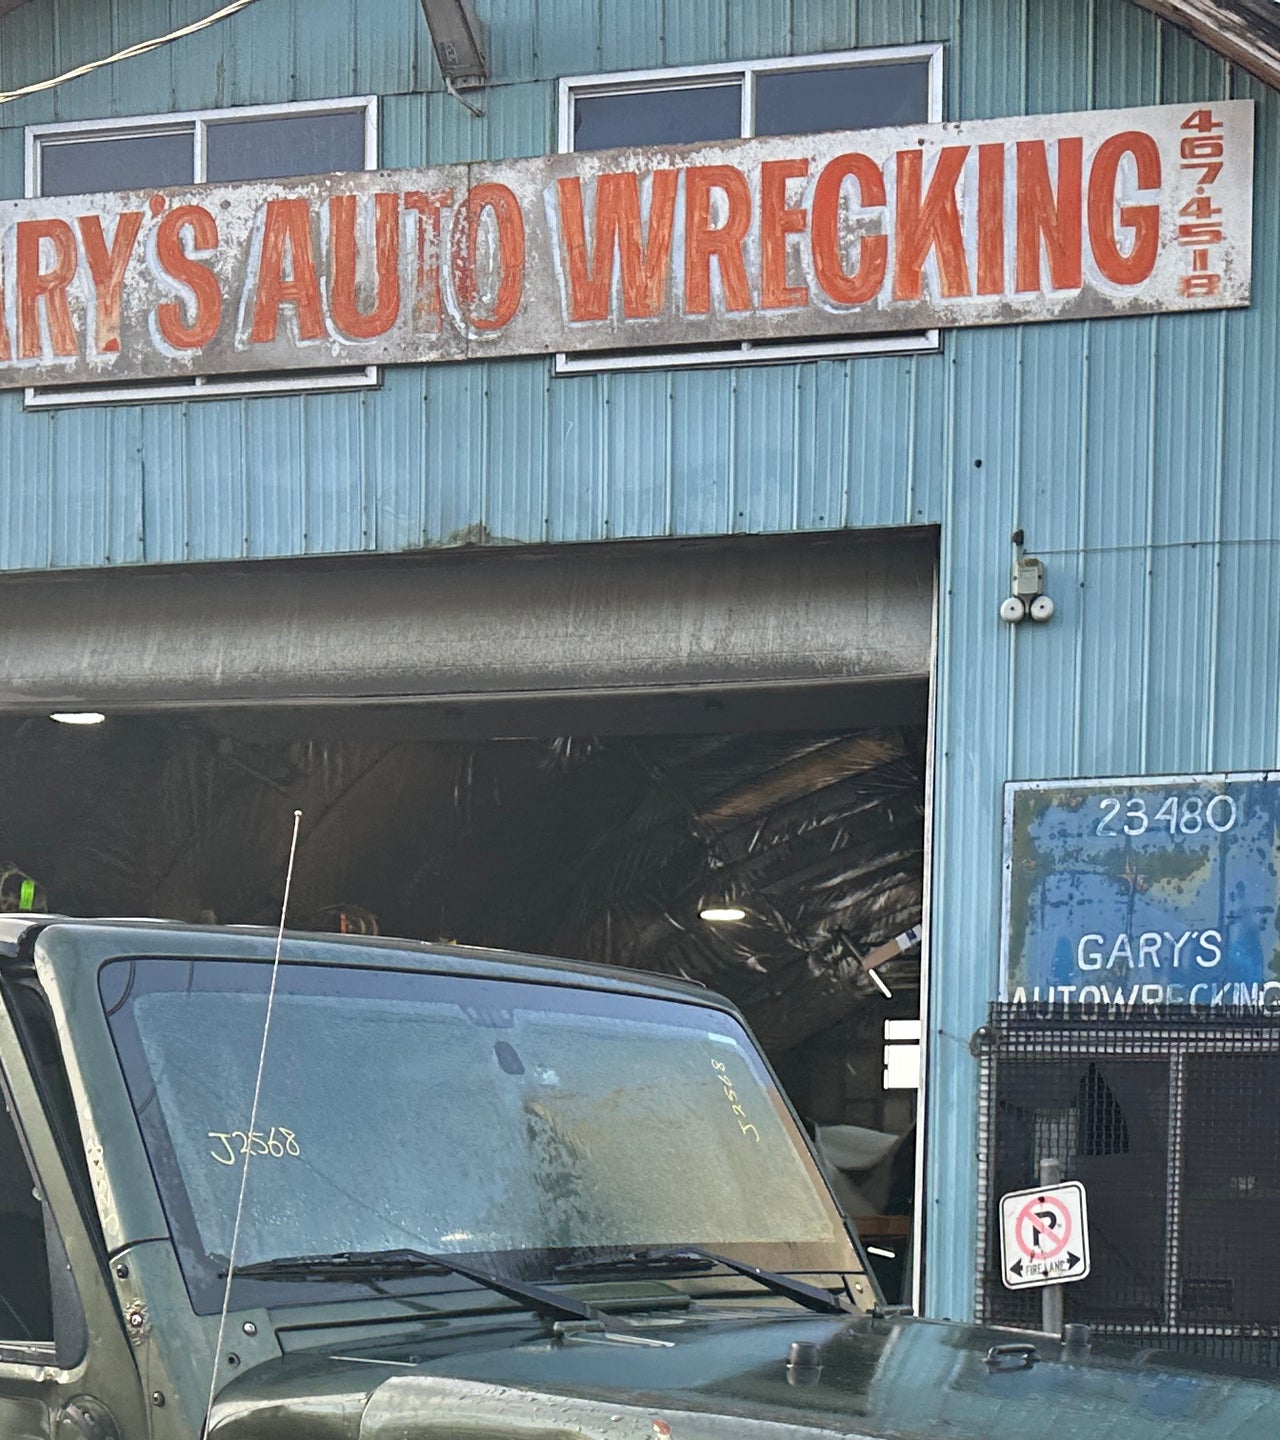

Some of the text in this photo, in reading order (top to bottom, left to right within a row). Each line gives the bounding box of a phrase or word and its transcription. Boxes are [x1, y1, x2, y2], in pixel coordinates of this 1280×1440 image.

[250, 182, 525, 344] AUTO
[558, 130, 1162, 322] WRECKING
[1096, 794, 1237, 837] 23480
[1077, 930, 1222, 971] GARY'S
[711, 1058, 759, 1142] J2568
[209, 1127, 300, 1166] J2568
[1025, 1263, 1042, 1276] FIRE
